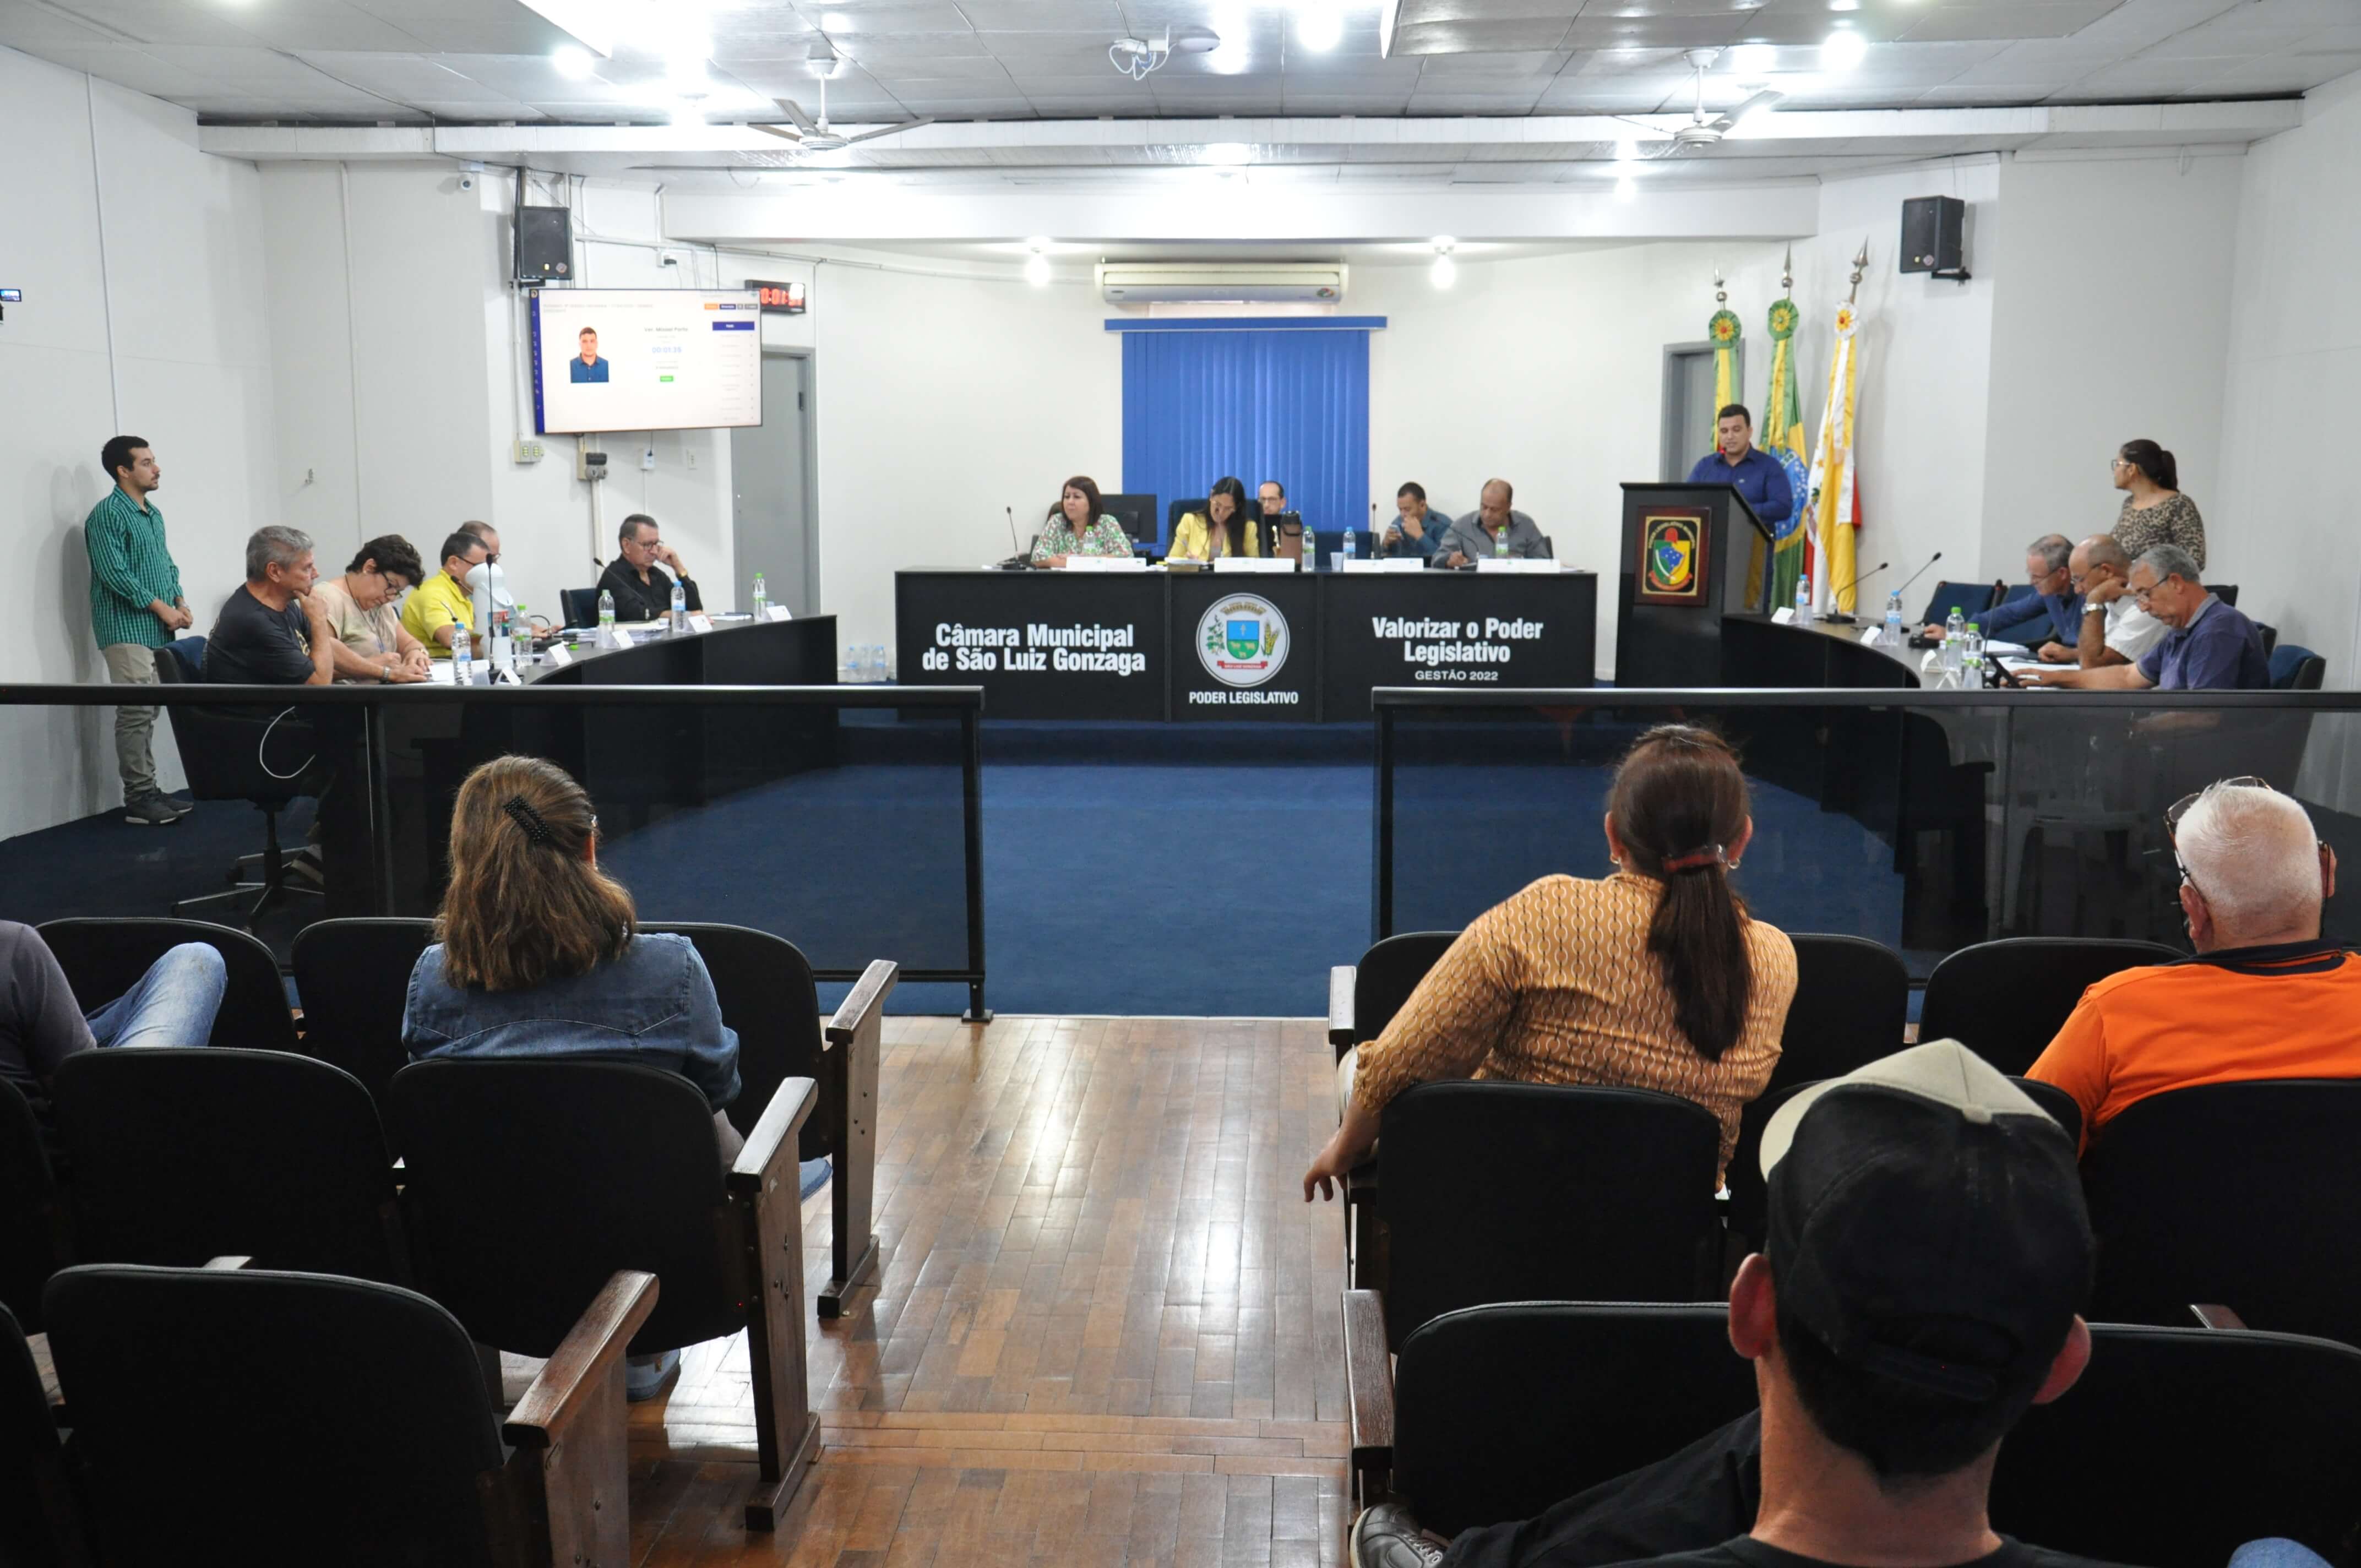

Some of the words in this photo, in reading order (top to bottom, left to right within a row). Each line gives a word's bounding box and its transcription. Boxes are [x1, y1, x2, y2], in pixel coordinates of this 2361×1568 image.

[935, 623, 1020, 647] Câmara
[1027, 623, 1133, 652] Municipal
[1372, 617, 1461, 639] Valorizar
[1466, 623, 1479, 639] o
[1485, 618, 1544, 639] Poder
[922, 647, 949, 671] de
[956, 647, 997, 671] São
[1004, 647, 1047, 671] Luiz
[1053, 647, 1146, 677] Gonzaga
[1404, 640, 1510, 666] Legislativo
[1415, 669, 1467, 680] GESTÃO
[1470, 671, 1498, 681] 2022
[1189, 691, 1227, 704] PODER
[1229, 691, 1298, 704] LEGISLATIVO
